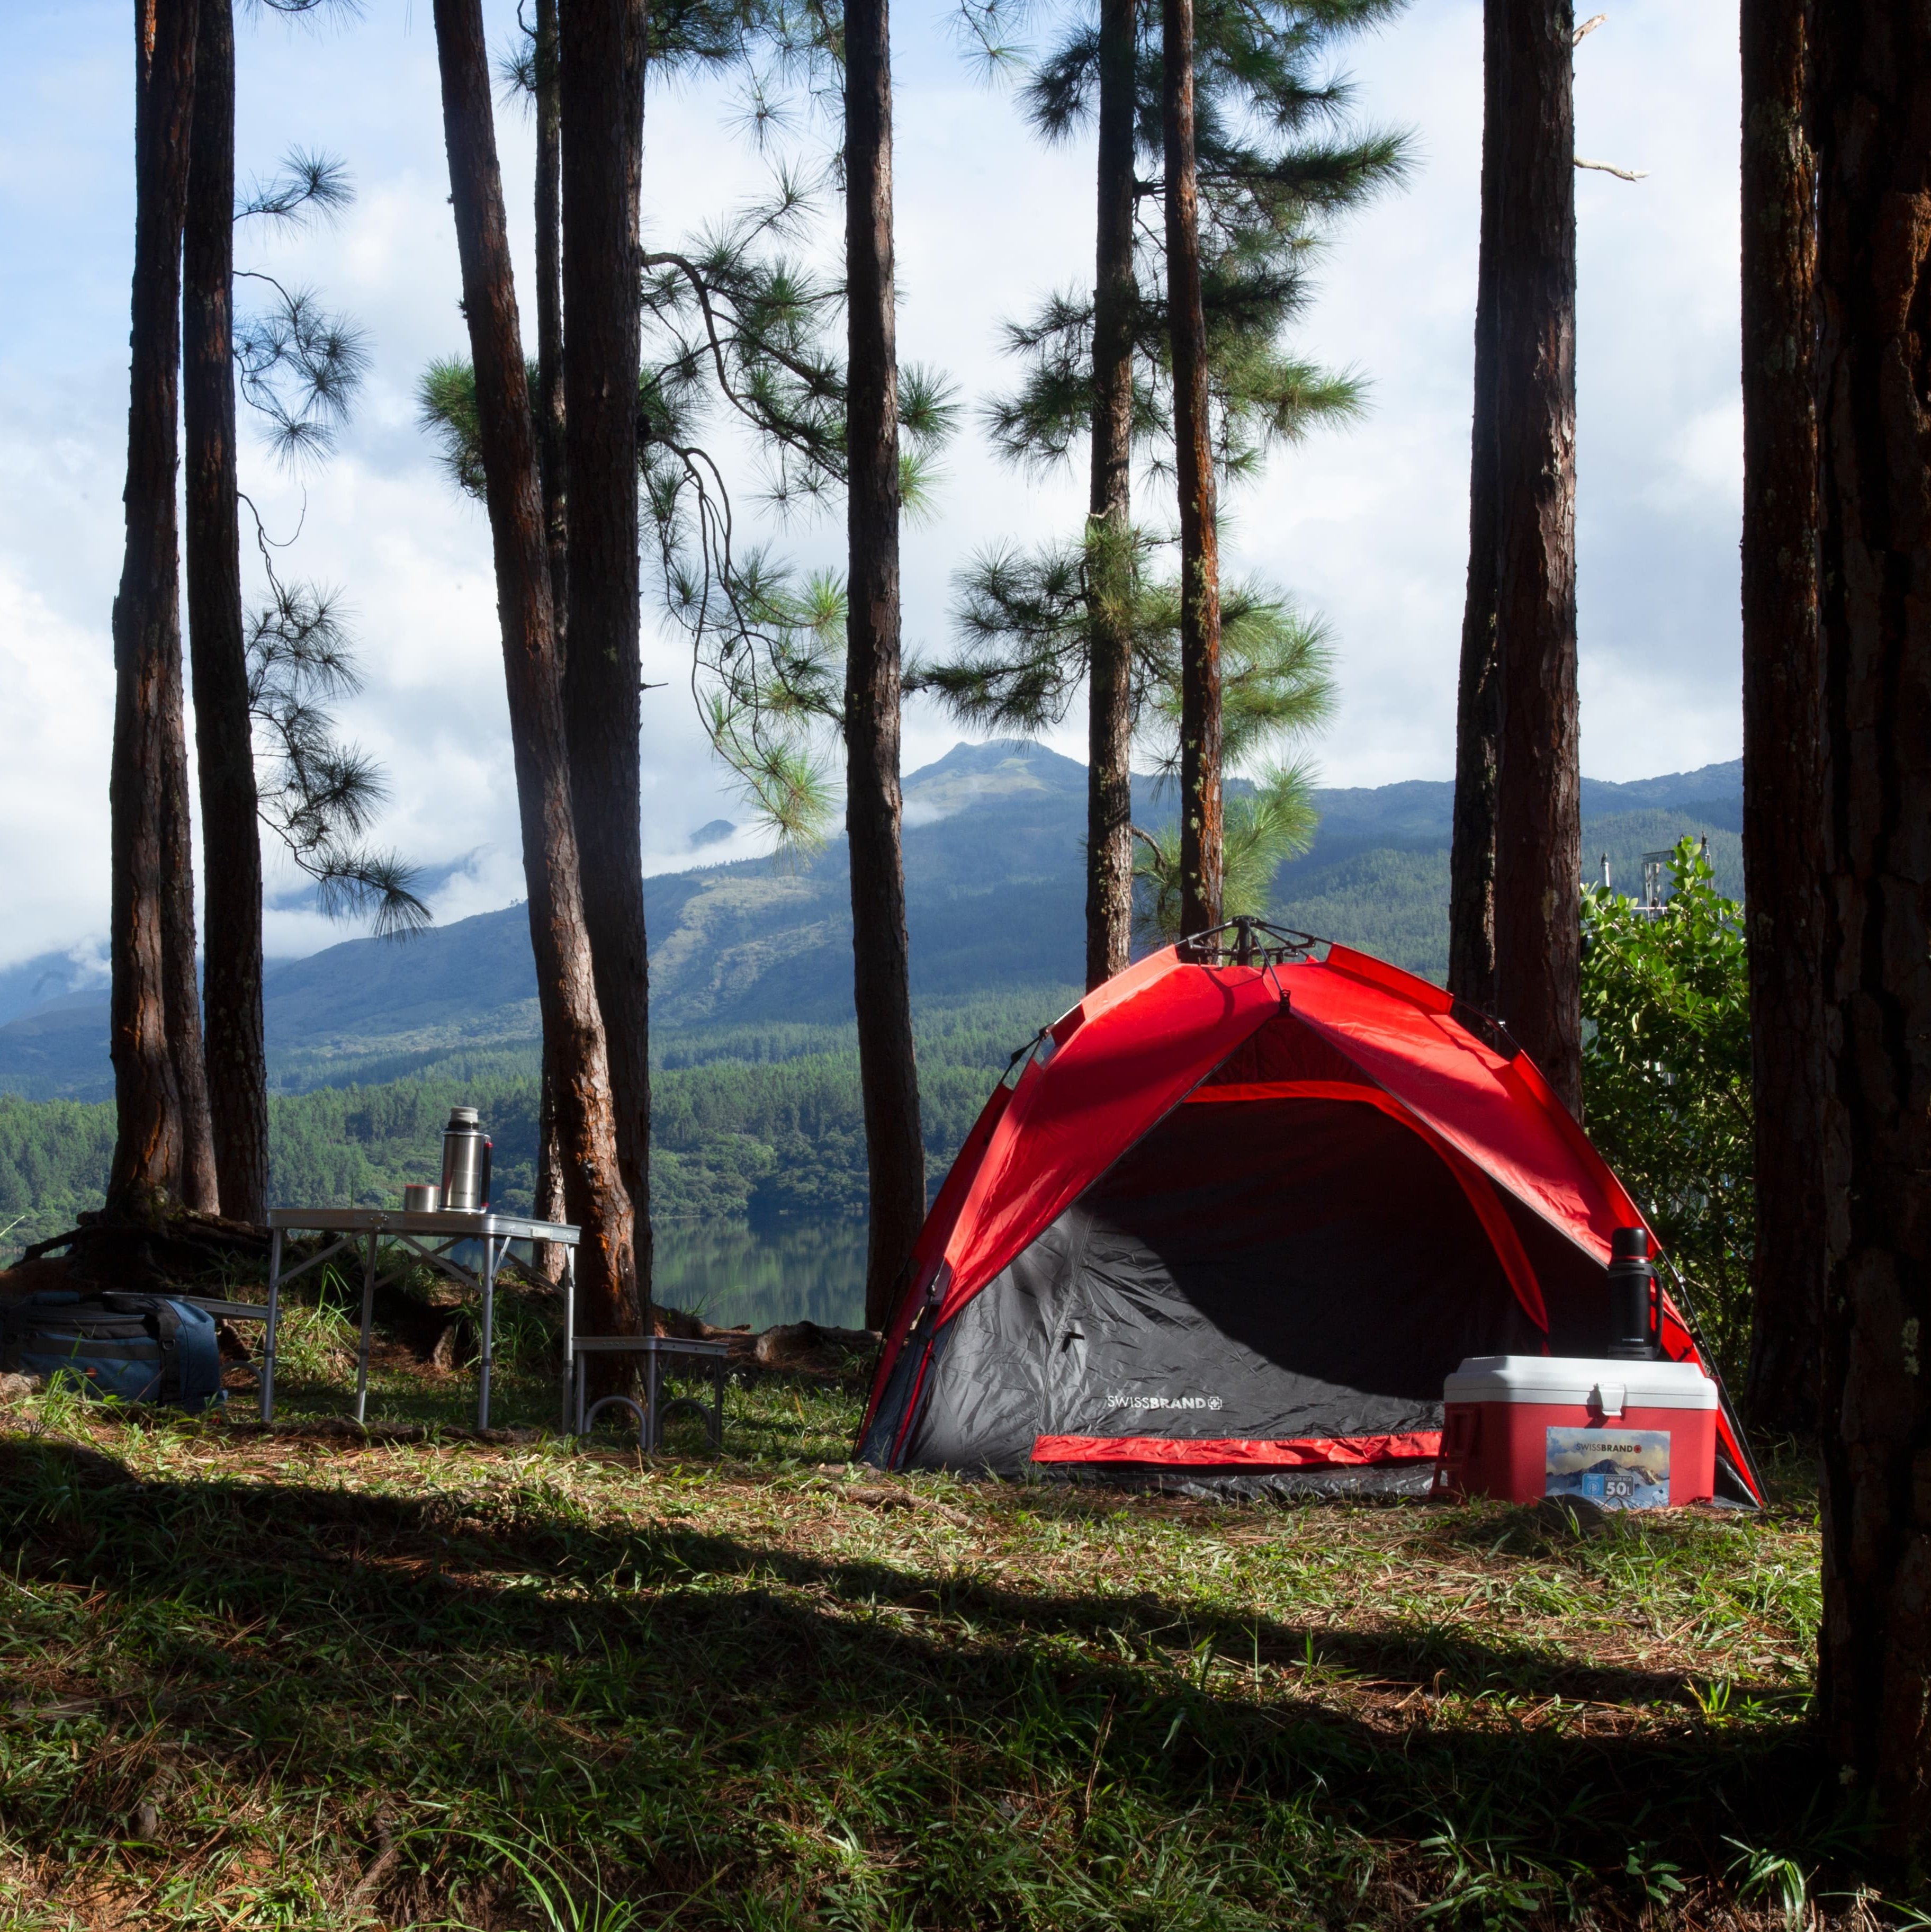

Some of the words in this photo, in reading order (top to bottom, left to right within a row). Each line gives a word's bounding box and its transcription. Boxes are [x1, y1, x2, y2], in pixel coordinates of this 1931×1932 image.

[1107, 1395, 1206, 1409] SWISSBRAND
[1576, 1443, 1633, 1453] SWISSBRAND
[1606, 1482, 1631, 1496] 50L
